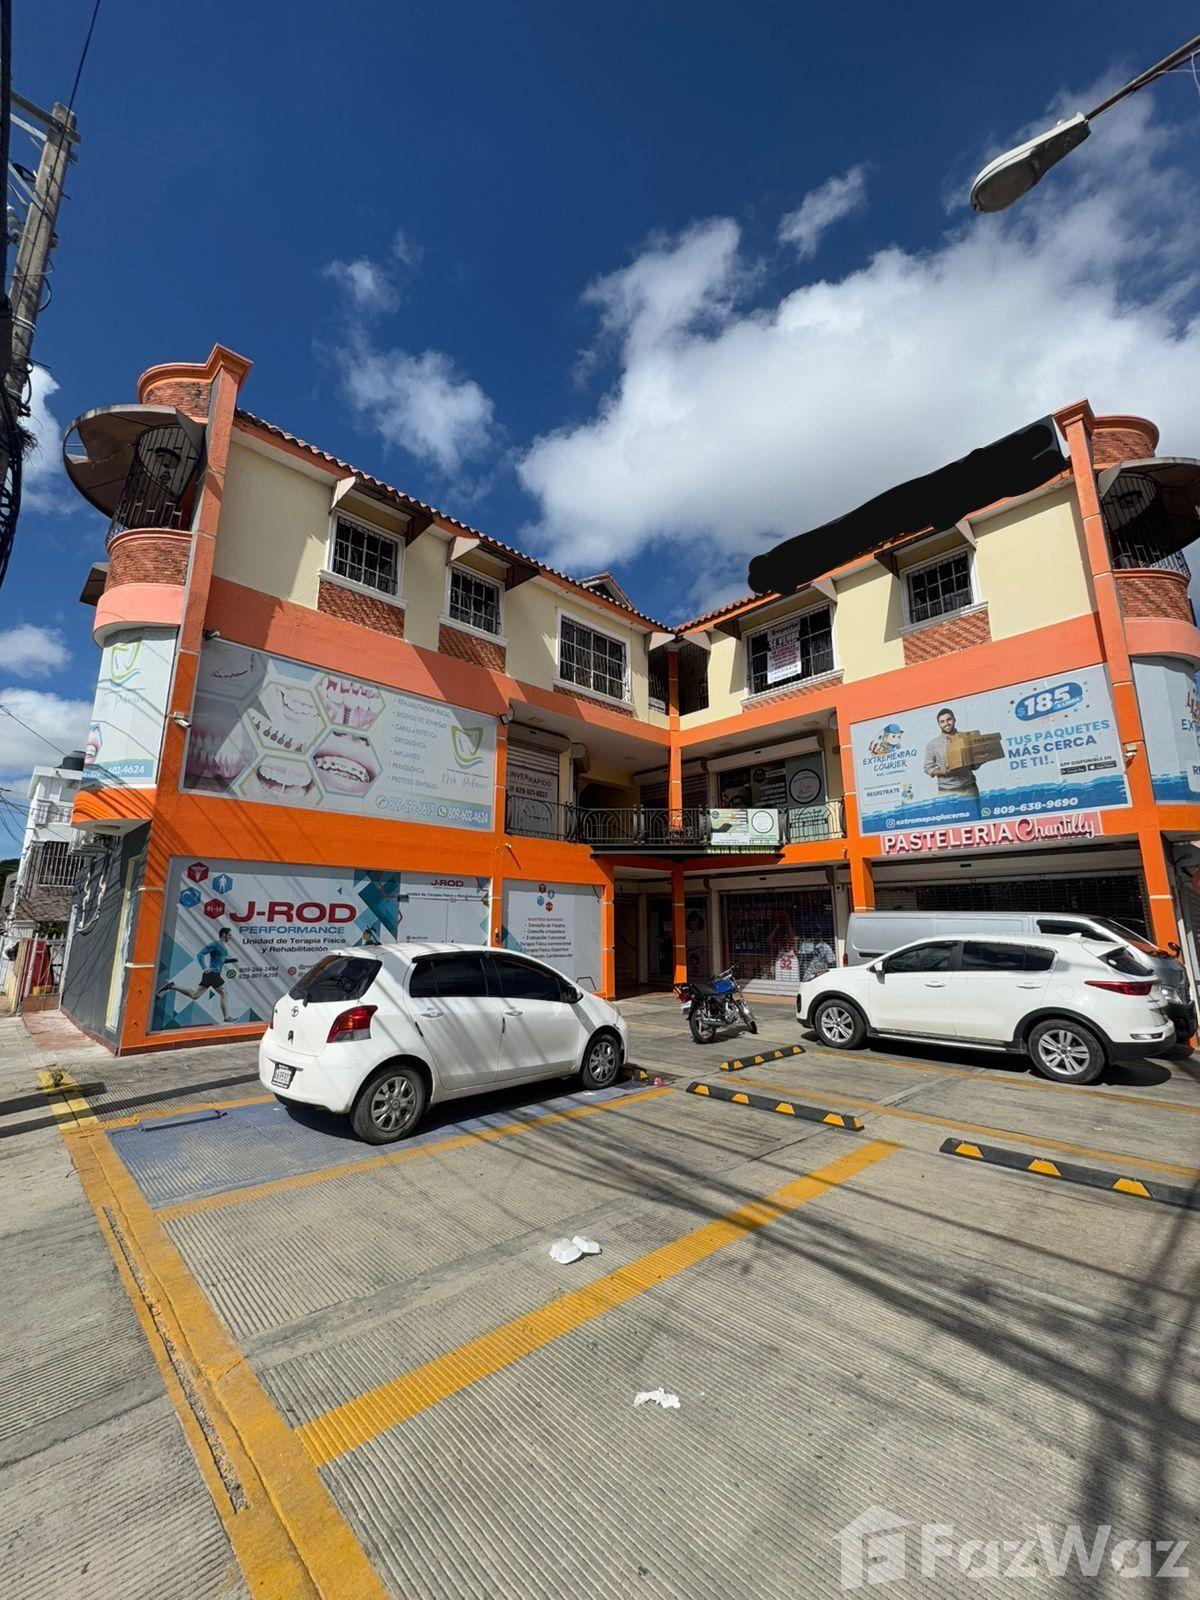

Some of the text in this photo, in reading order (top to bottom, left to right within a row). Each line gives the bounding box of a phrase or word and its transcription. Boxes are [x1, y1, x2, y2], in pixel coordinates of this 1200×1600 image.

[1006, 719, 1110, 747] TUS PAQUETES
[1008, 734, 1098, 759] MÁS CERCA
[862, 752, 898, 766] EXTREME
[873, 759, 907, 772] COURIER
[1010, 759, 1028, 771] DE
[993, 796, 1079, 816] 809-638-9690
[896, 811, 970, 826] extremepaqlucerna
[1015, 812, 1095, 840] Chantilly
[430, 879, 464, 888] J-ROD
[229, 901, 357, 924] J-ROD
[238, 925, 345, 935] PERFORMANCE
[242, 937, 274, 945] Unidad
[276, 937, 288, 945] de
[290, 937, 321, 946] Terapia
[269, 945, 328, 953] Rehabilitación
